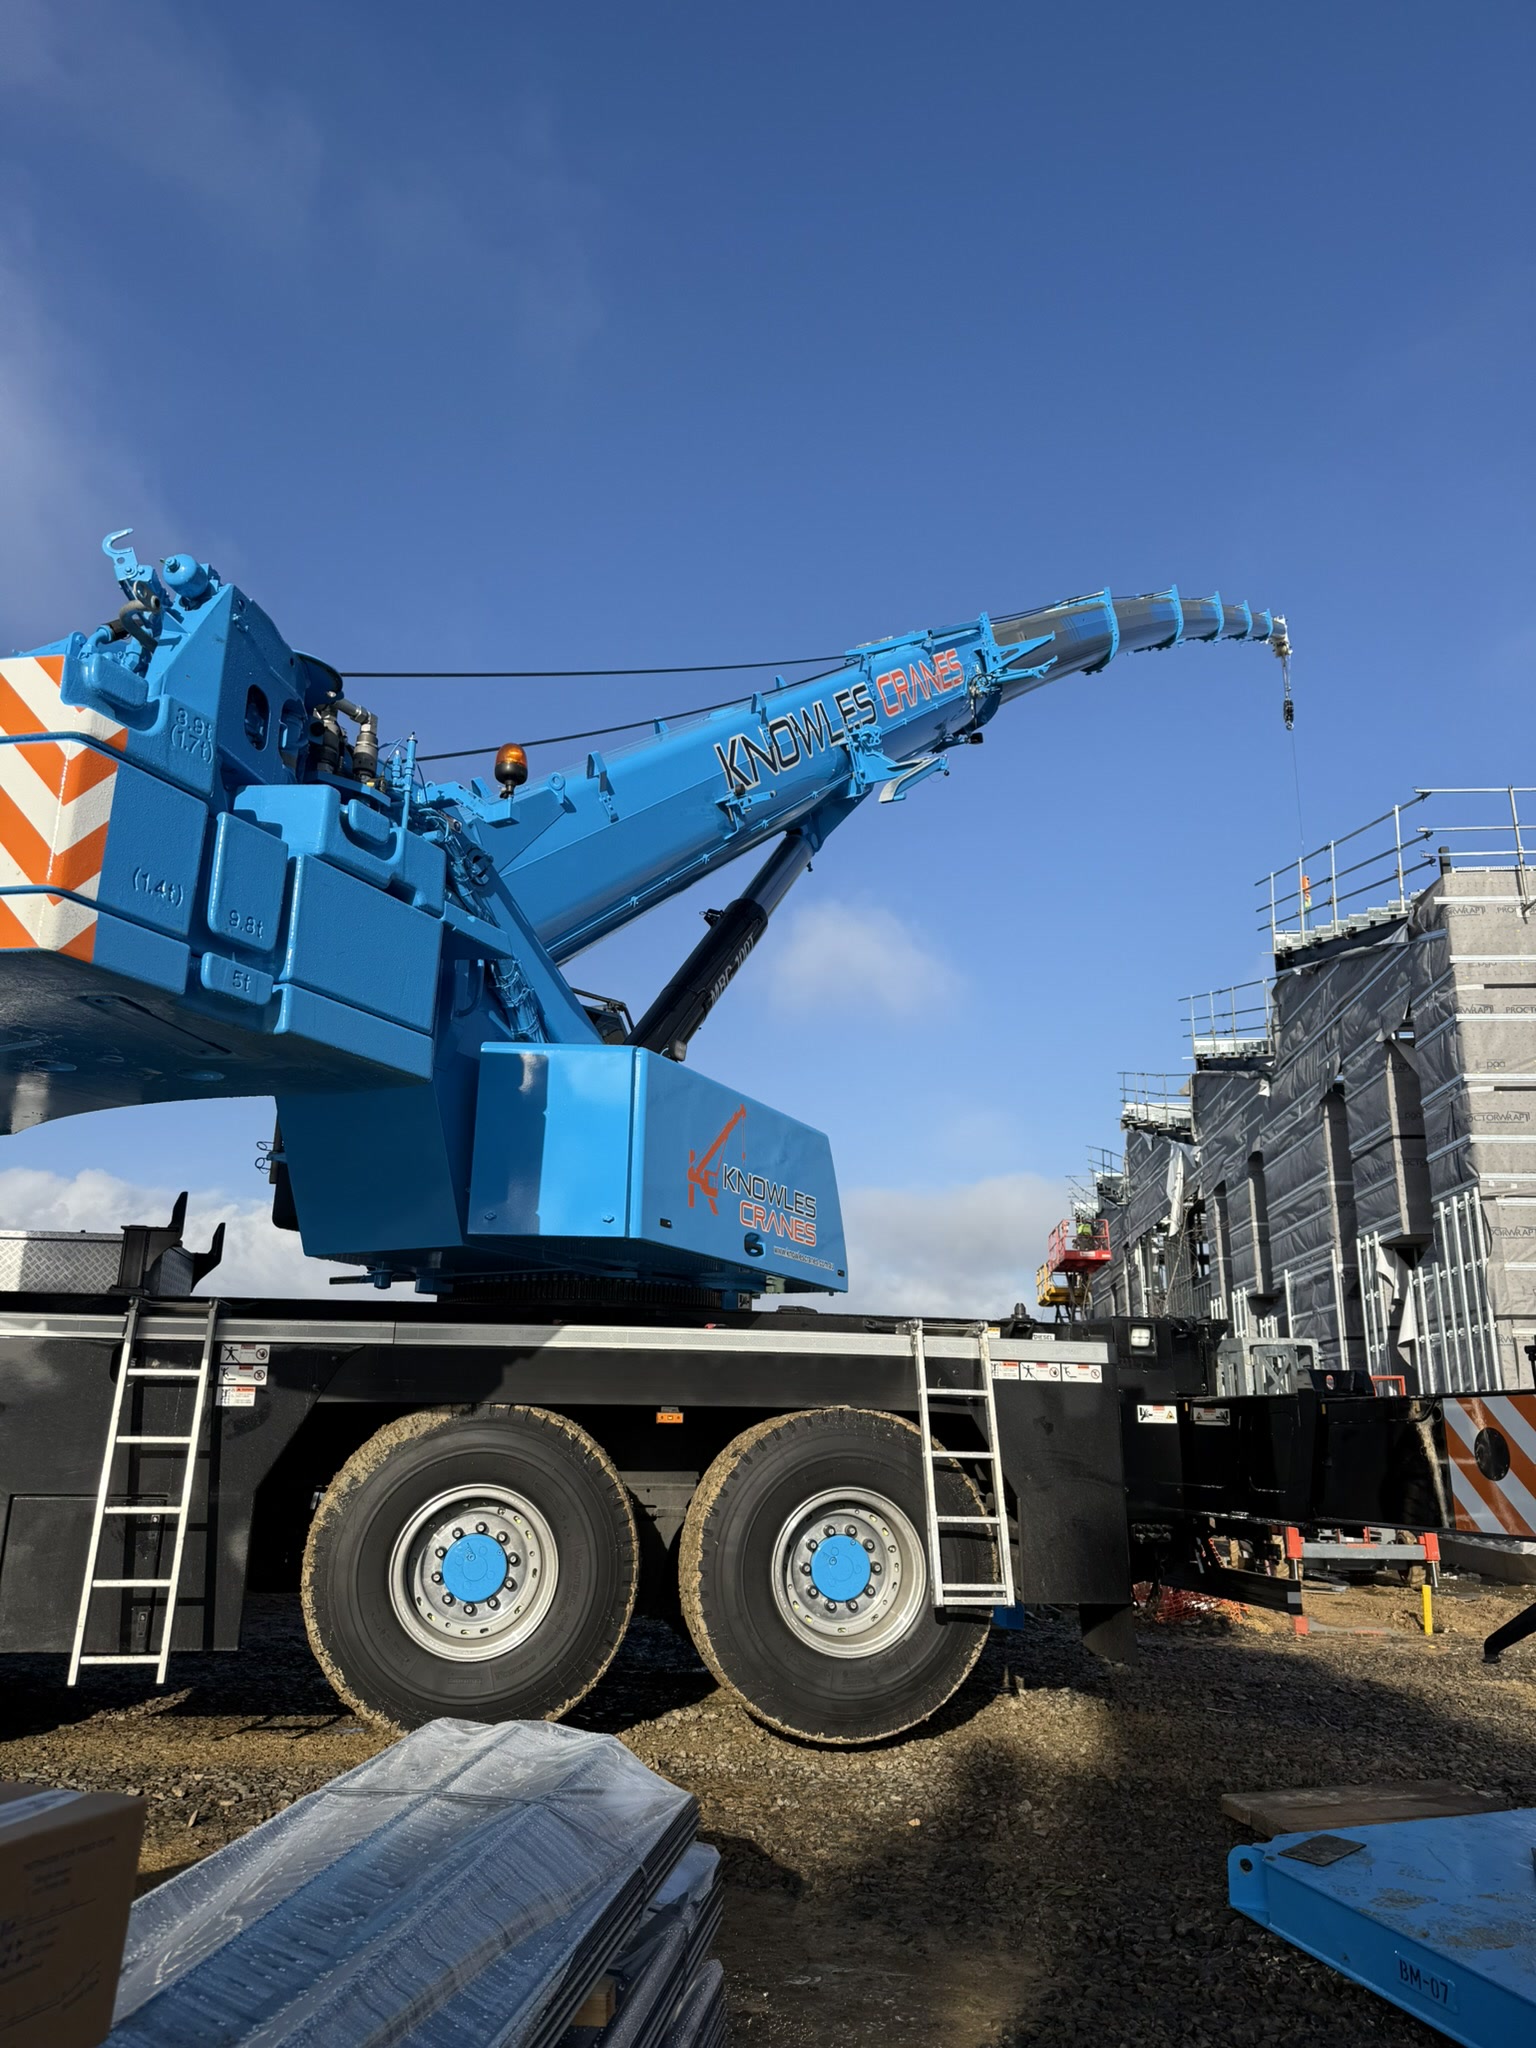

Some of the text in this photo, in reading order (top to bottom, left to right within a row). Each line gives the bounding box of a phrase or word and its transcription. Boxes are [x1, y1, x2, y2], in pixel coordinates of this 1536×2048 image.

[714, 648, 964, 790] KNOWLES CRANES
[171, 724, 214, 764] (1.7t)
[133, 867, 184, 908] (1.4t)
[229, 909, 263, 939] 9.8t
[232, 969, 251, 992] 5t
[722, 1163, 816, 1220] KNOWLES
[740, 1200, 816, 1247] CRANES
[1033, 1333, 1054, 1341] DIESEL
[1399, 1959, 1449, 2005] BM-07
